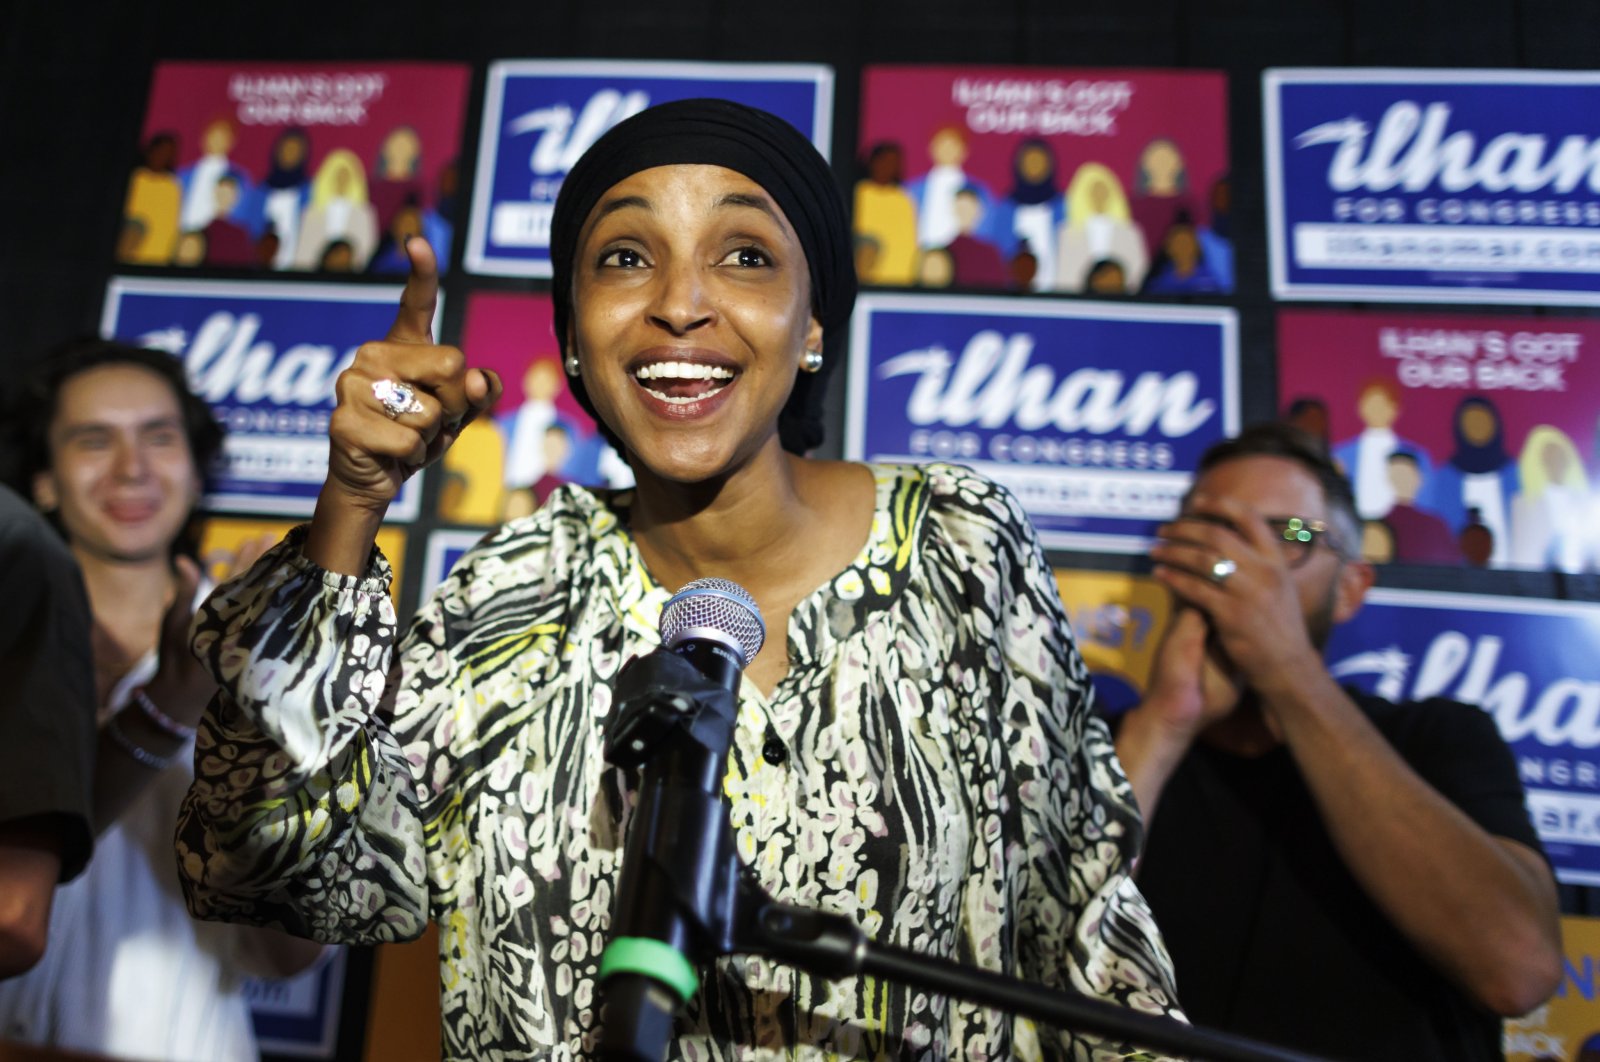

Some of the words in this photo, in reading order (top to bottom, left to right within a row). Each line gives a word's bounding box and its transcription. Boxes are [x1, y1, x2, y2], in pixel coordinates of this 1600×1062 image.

[1334, 197, 1405, 223] FOR
[1511, 332, 1583, 364] GOT
[876, 330, 1215, 438] ilhan
[1397, 356, 1470, 388] OUR
[1476, 359, 1566, 392] BACK
[909, 428, 981, 459] FOR
[989, 433, 1174, 470] CONGRESS
